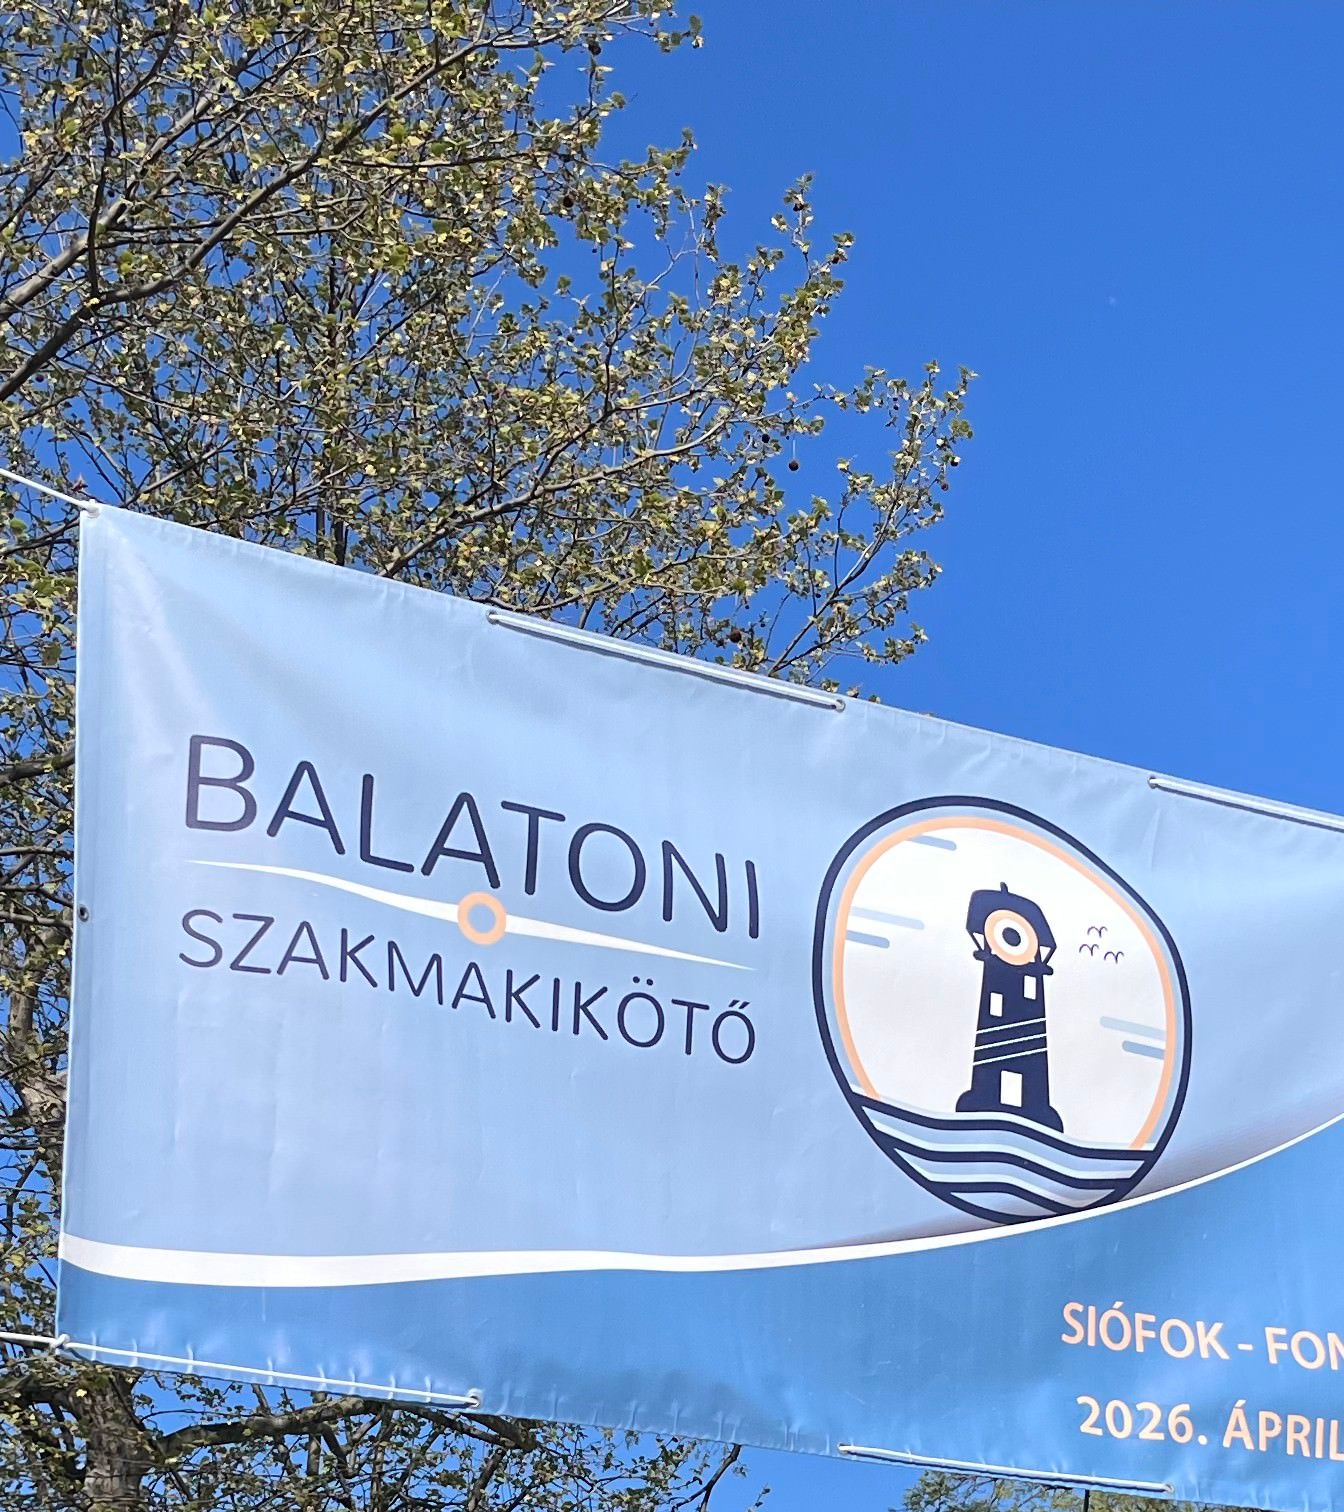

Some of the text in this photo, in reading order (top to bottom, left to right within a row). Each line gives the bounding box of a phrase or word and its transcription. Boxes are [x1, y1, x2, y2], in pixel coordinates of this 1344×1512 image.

[184, 734, 761, 939] BALATONI
[178, 909, 757, 1064] SZAKMAKIKÖTŐ
[1060, 1300, 1230, 1360] SIÓFOK
[1076, 1396, 1209, 1446] 2026.
